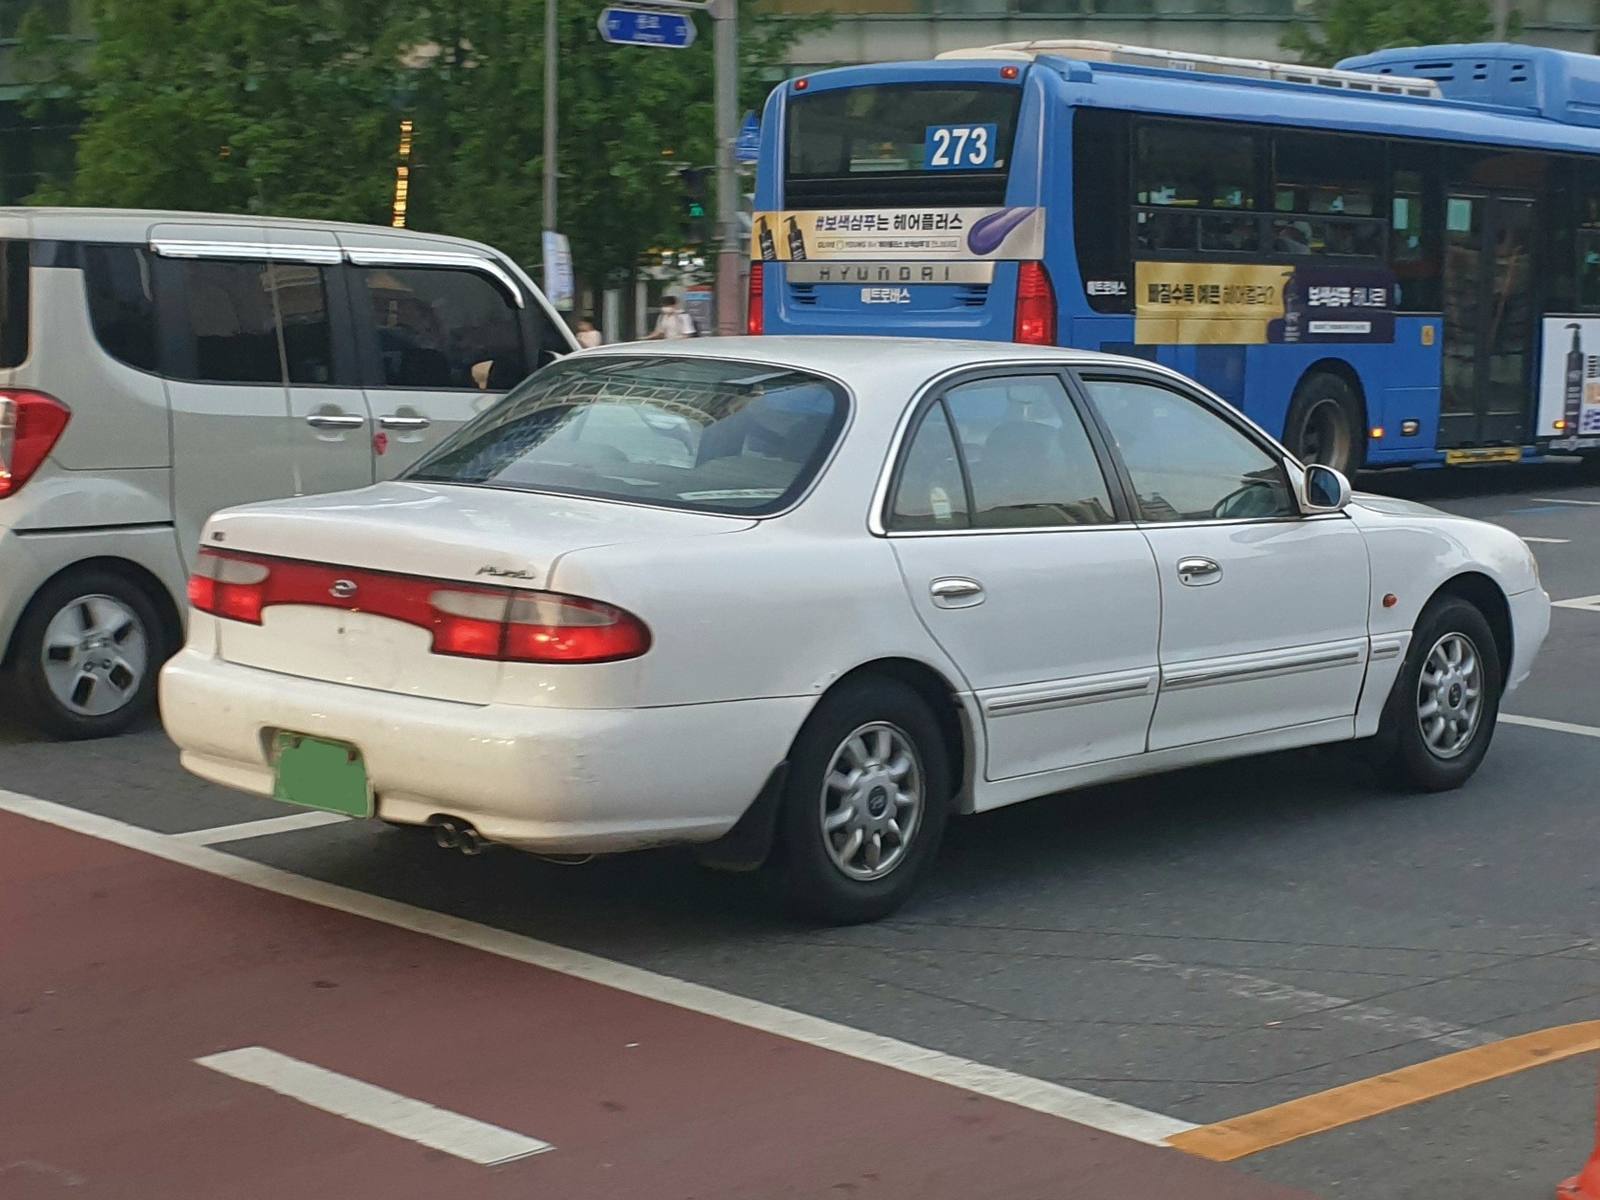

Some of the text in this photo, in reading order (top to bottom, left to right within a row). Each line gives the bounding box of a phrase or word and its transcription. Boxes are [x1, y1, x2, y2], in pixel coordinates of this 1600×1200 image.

[931, 126, 988, 166] 273
[893, 213, 963, 231] 헤어플러스
[819, 266, 949, 281] HYUNDAI
